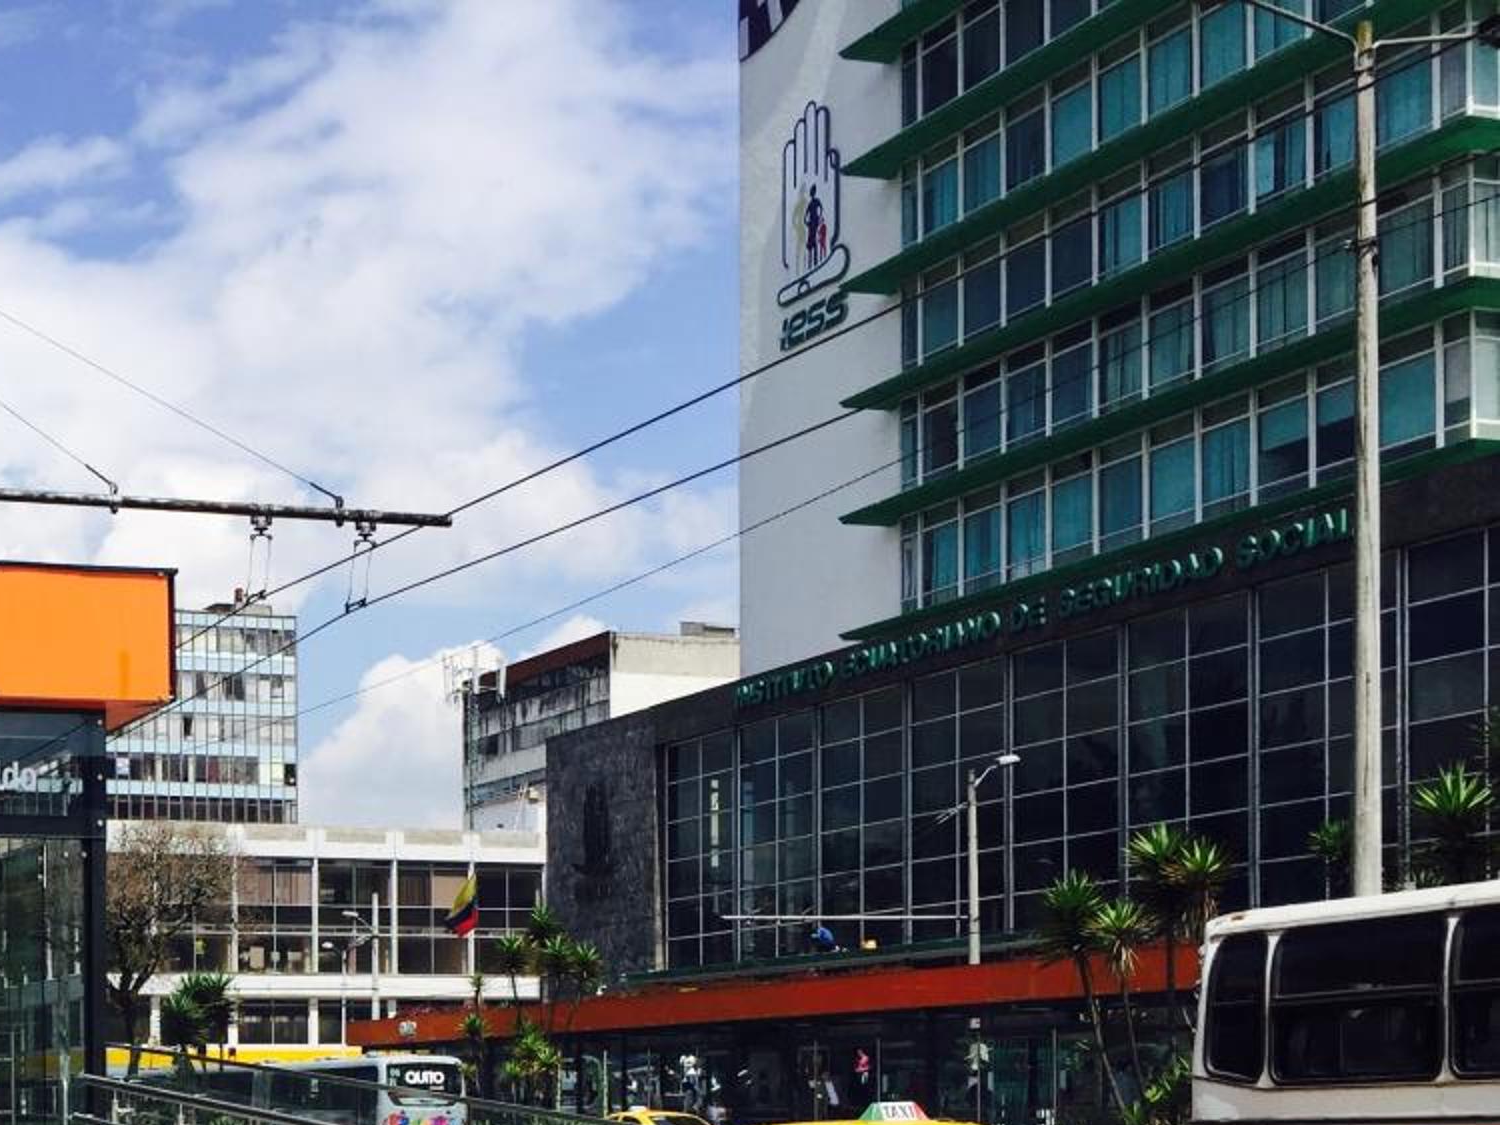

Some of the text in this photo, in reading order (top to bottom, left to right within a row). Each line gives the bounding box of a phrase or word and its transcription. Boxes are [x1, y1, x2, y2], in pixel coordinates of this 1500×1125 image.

[1011, 597, 1047, 633] DE
[1059, 547, 1222, 617] SEGURIDAD
[1236, 508, 1354, 569] SOCIAL
[883, 1104, 916, 1119] TAXI
